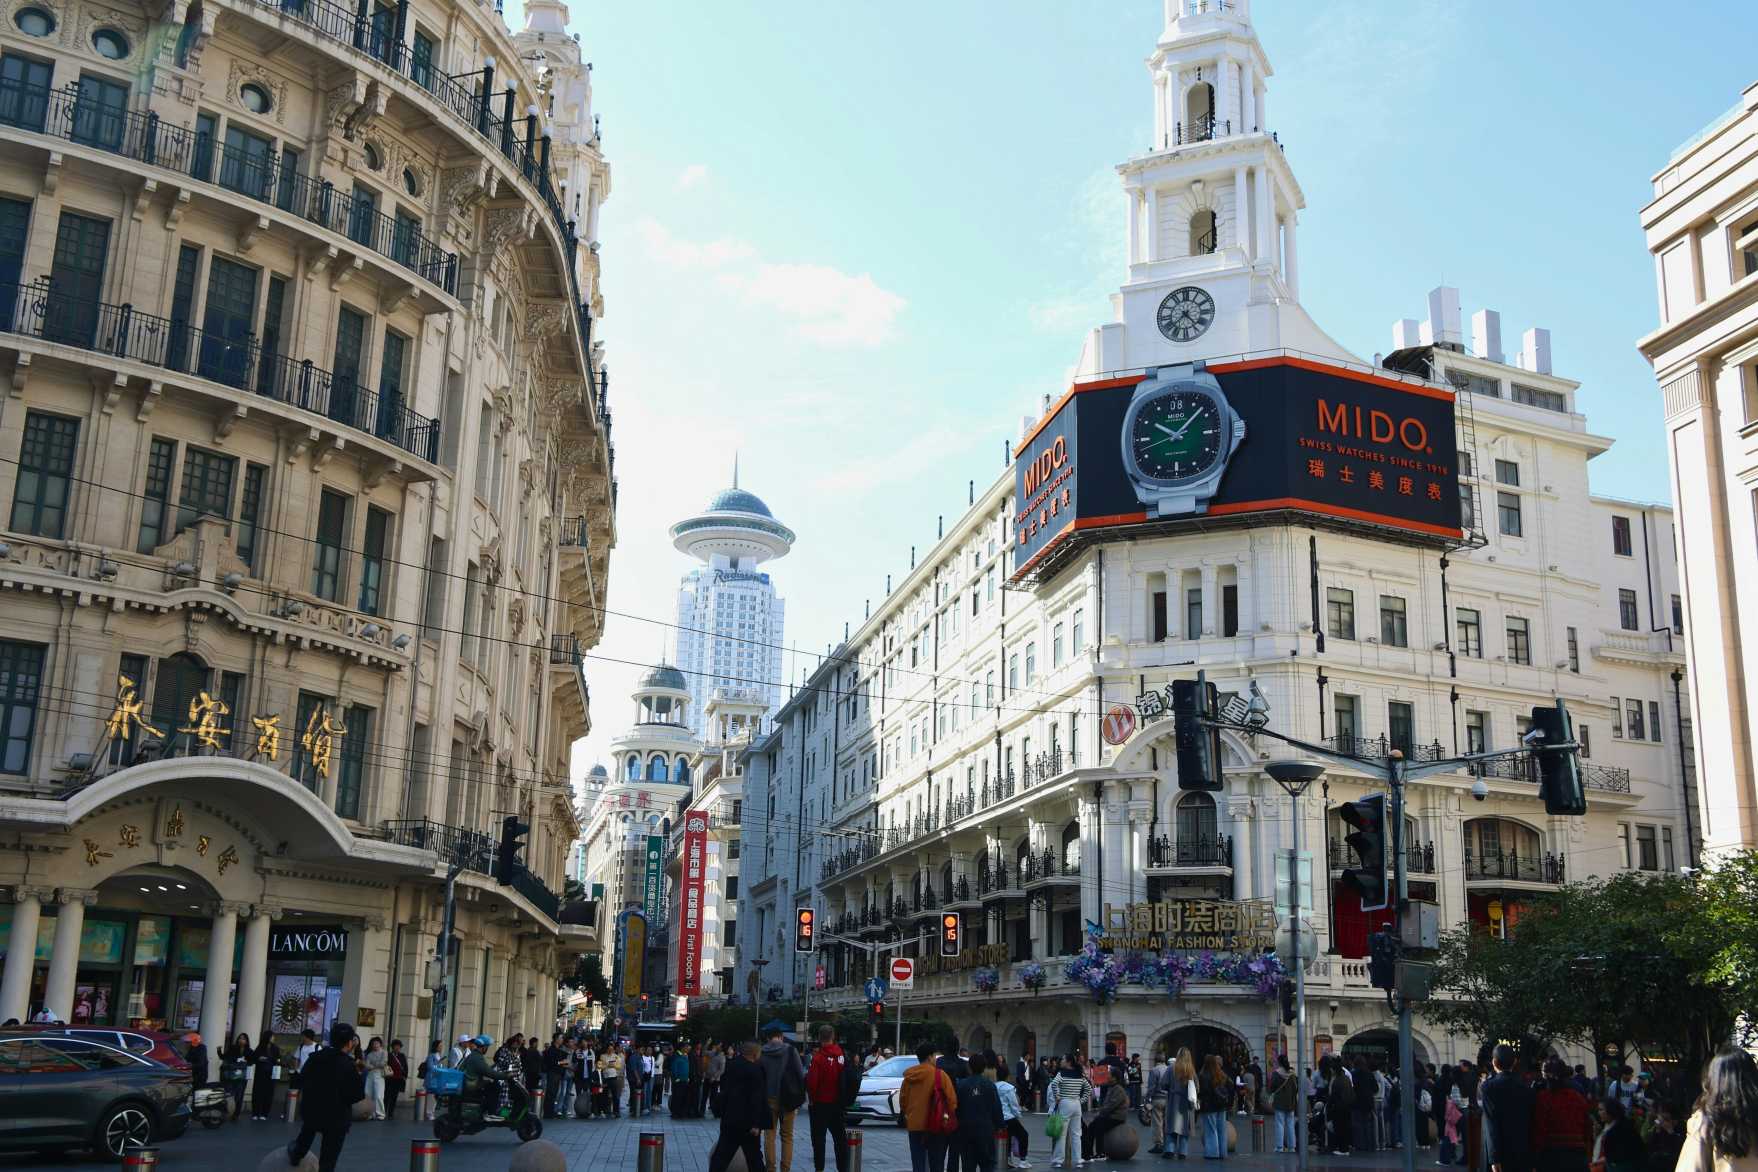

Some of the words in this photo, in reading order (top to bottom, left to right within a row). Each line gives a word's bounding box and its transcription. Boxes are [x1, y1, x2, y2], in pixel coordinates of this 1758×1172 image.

[1167, 412, 1185, 420] MIDO
[1298, 437, 1332, 452] SWISS
[1336, 445, 1386, 463] WATCHES
[1390, 455, 1422, 470] SINCE
[1308, 458, 1441, 500] 瑞士美度表
[1103, 902, 1276, 933] 上海时装商店
[687, 934, 696, 950] First
[947, 929, 956, 940] 15
[1097, 936, 1162, 949] SHANGHAI
[1168, 936, 1224, 949] FASHION
[1230, 935, 1276, 948] STORE
[685, 952, 696, 989] Foodhll
